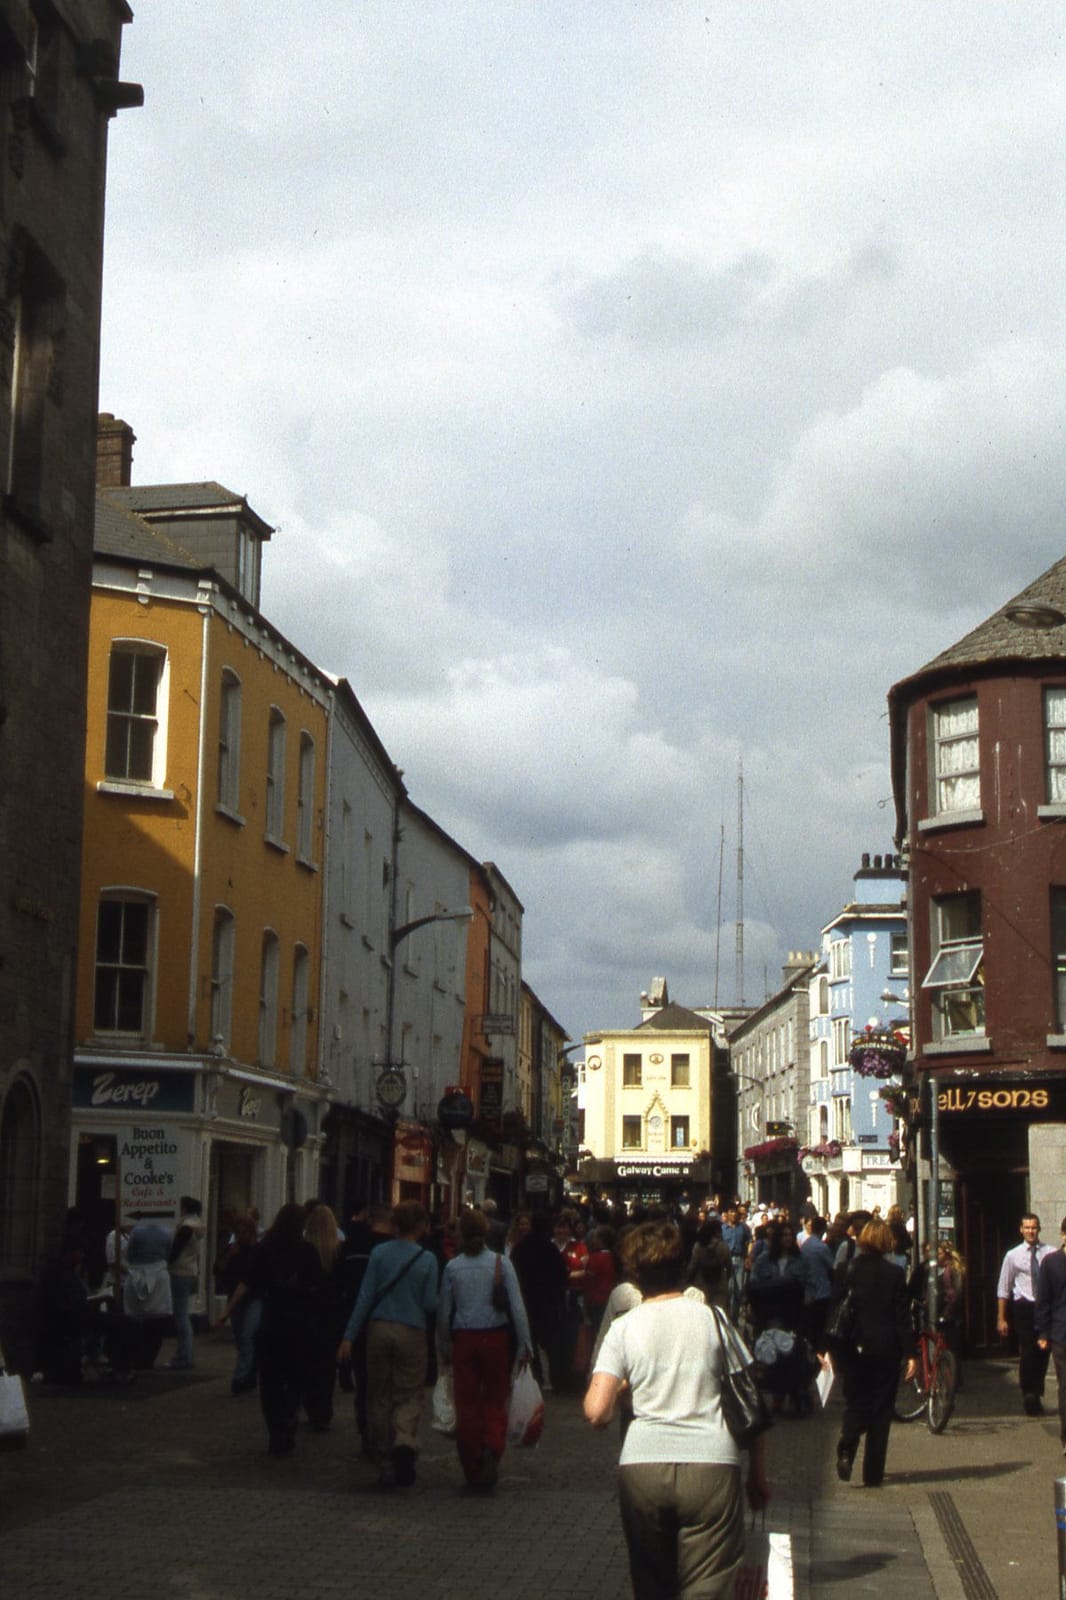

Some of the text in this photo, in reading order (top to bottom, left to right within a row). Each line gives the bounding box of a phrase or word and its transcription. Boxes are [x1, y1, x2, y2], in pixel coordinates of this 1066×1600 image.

[91, 1071, 160, 1106] Zerep
[133, 1127, 165, 1140] Buon
[121, 1142, 177, 1159] Appetito
[144, 1158, 152, 1169] &
[617, 1165, 652, 1177] Galway
[124, 1171, 174, 1185] Cooke's
